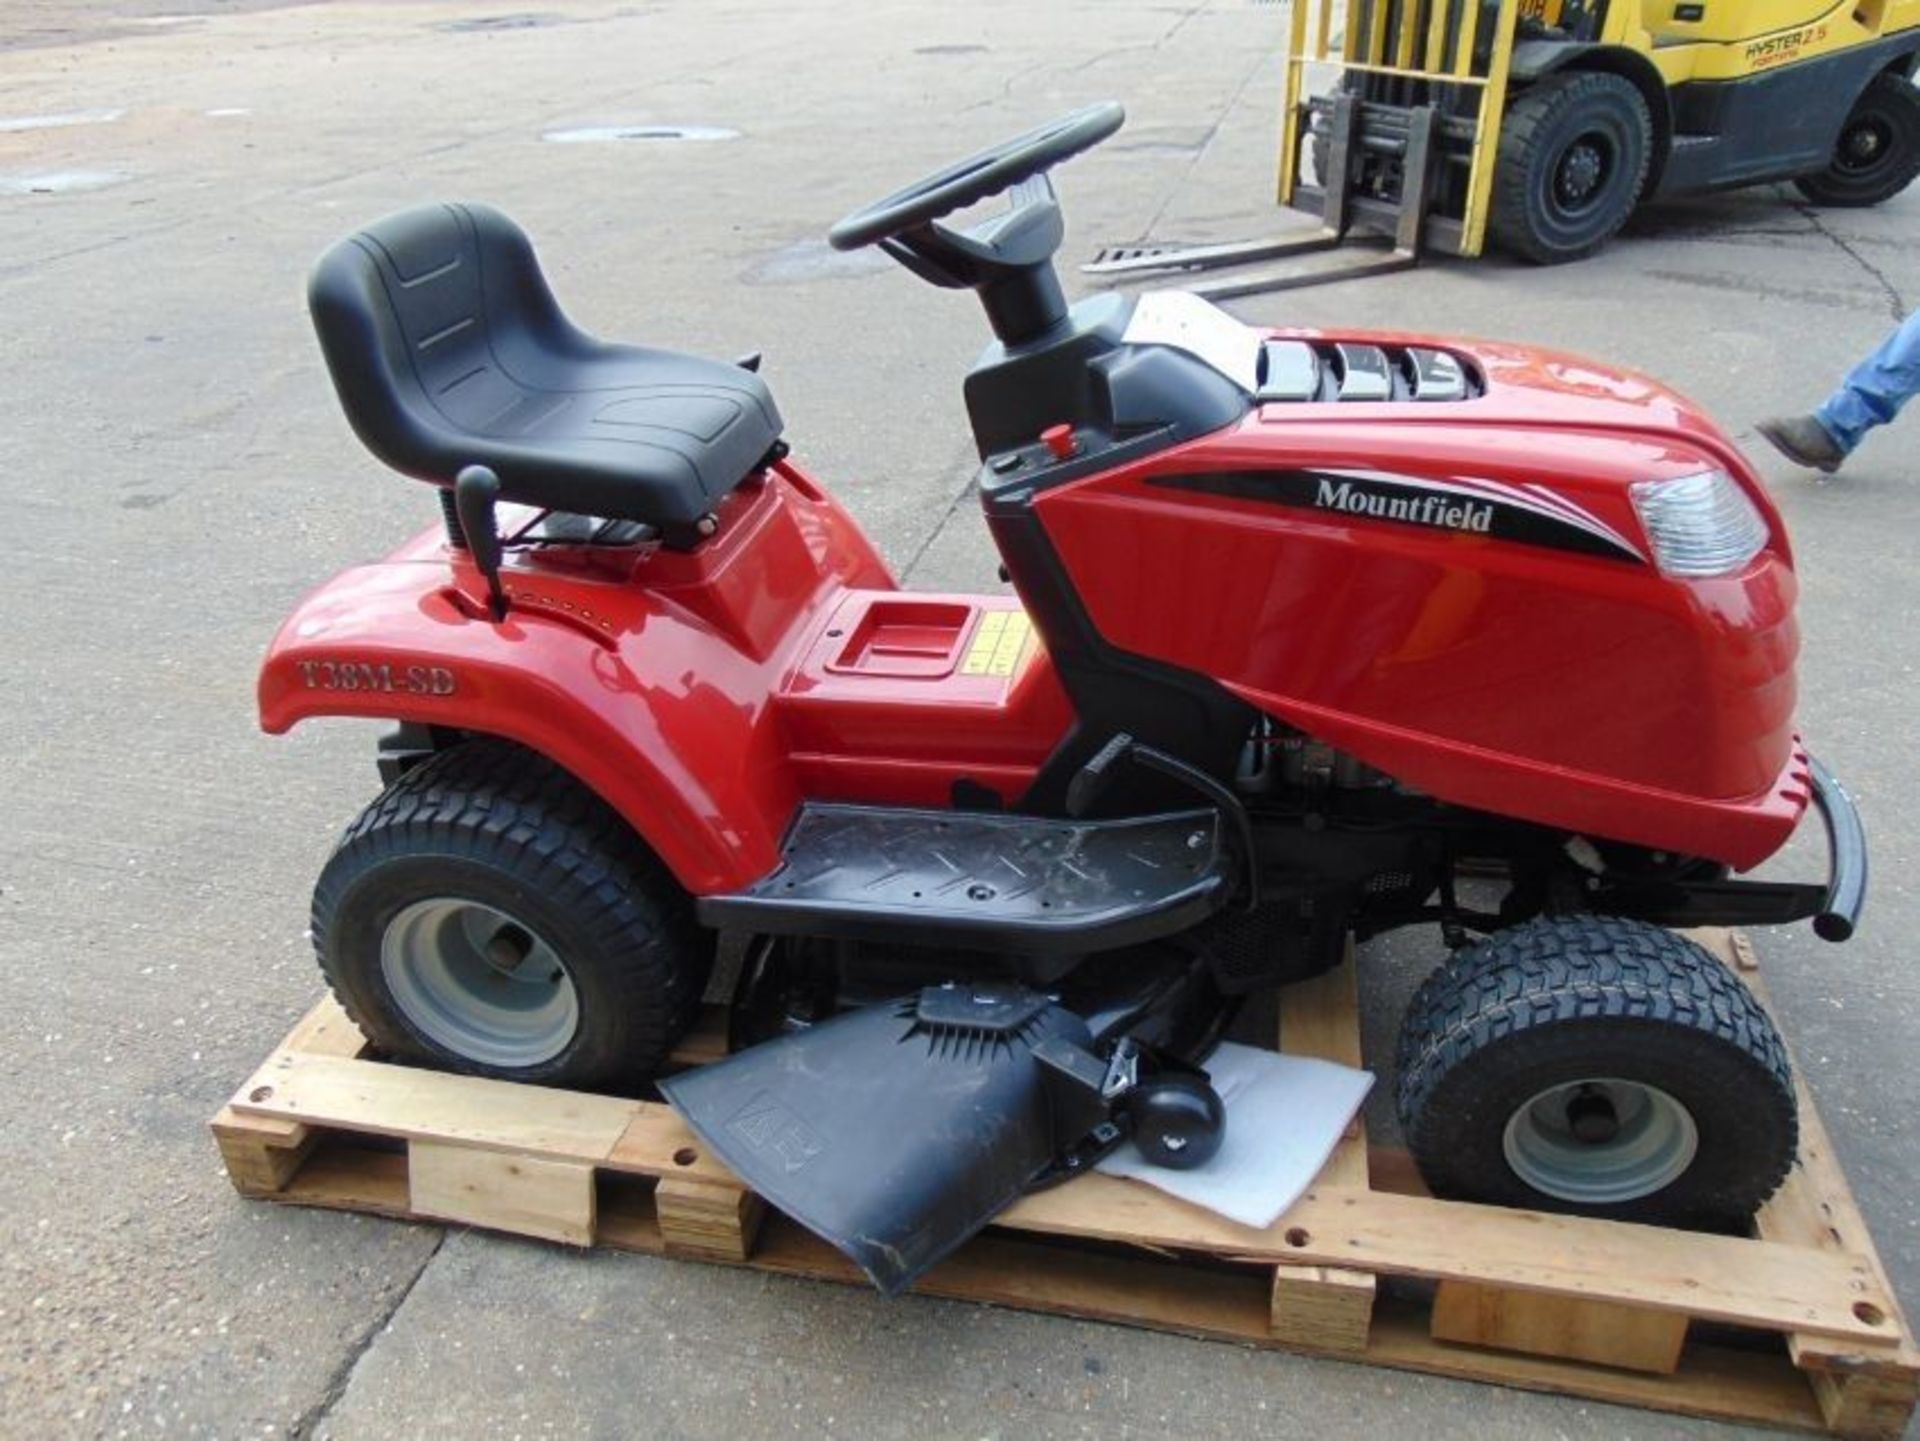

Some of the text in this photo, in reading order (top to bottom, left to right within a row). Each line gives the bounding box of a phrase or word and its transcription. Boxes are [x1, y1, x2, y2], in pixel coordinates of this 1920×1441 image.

[1745, 30, 1802, 59] HYSTER
[1315, 479, 1493, 533] Mountfield
[298, 660, 455, 696] T38M-SD
